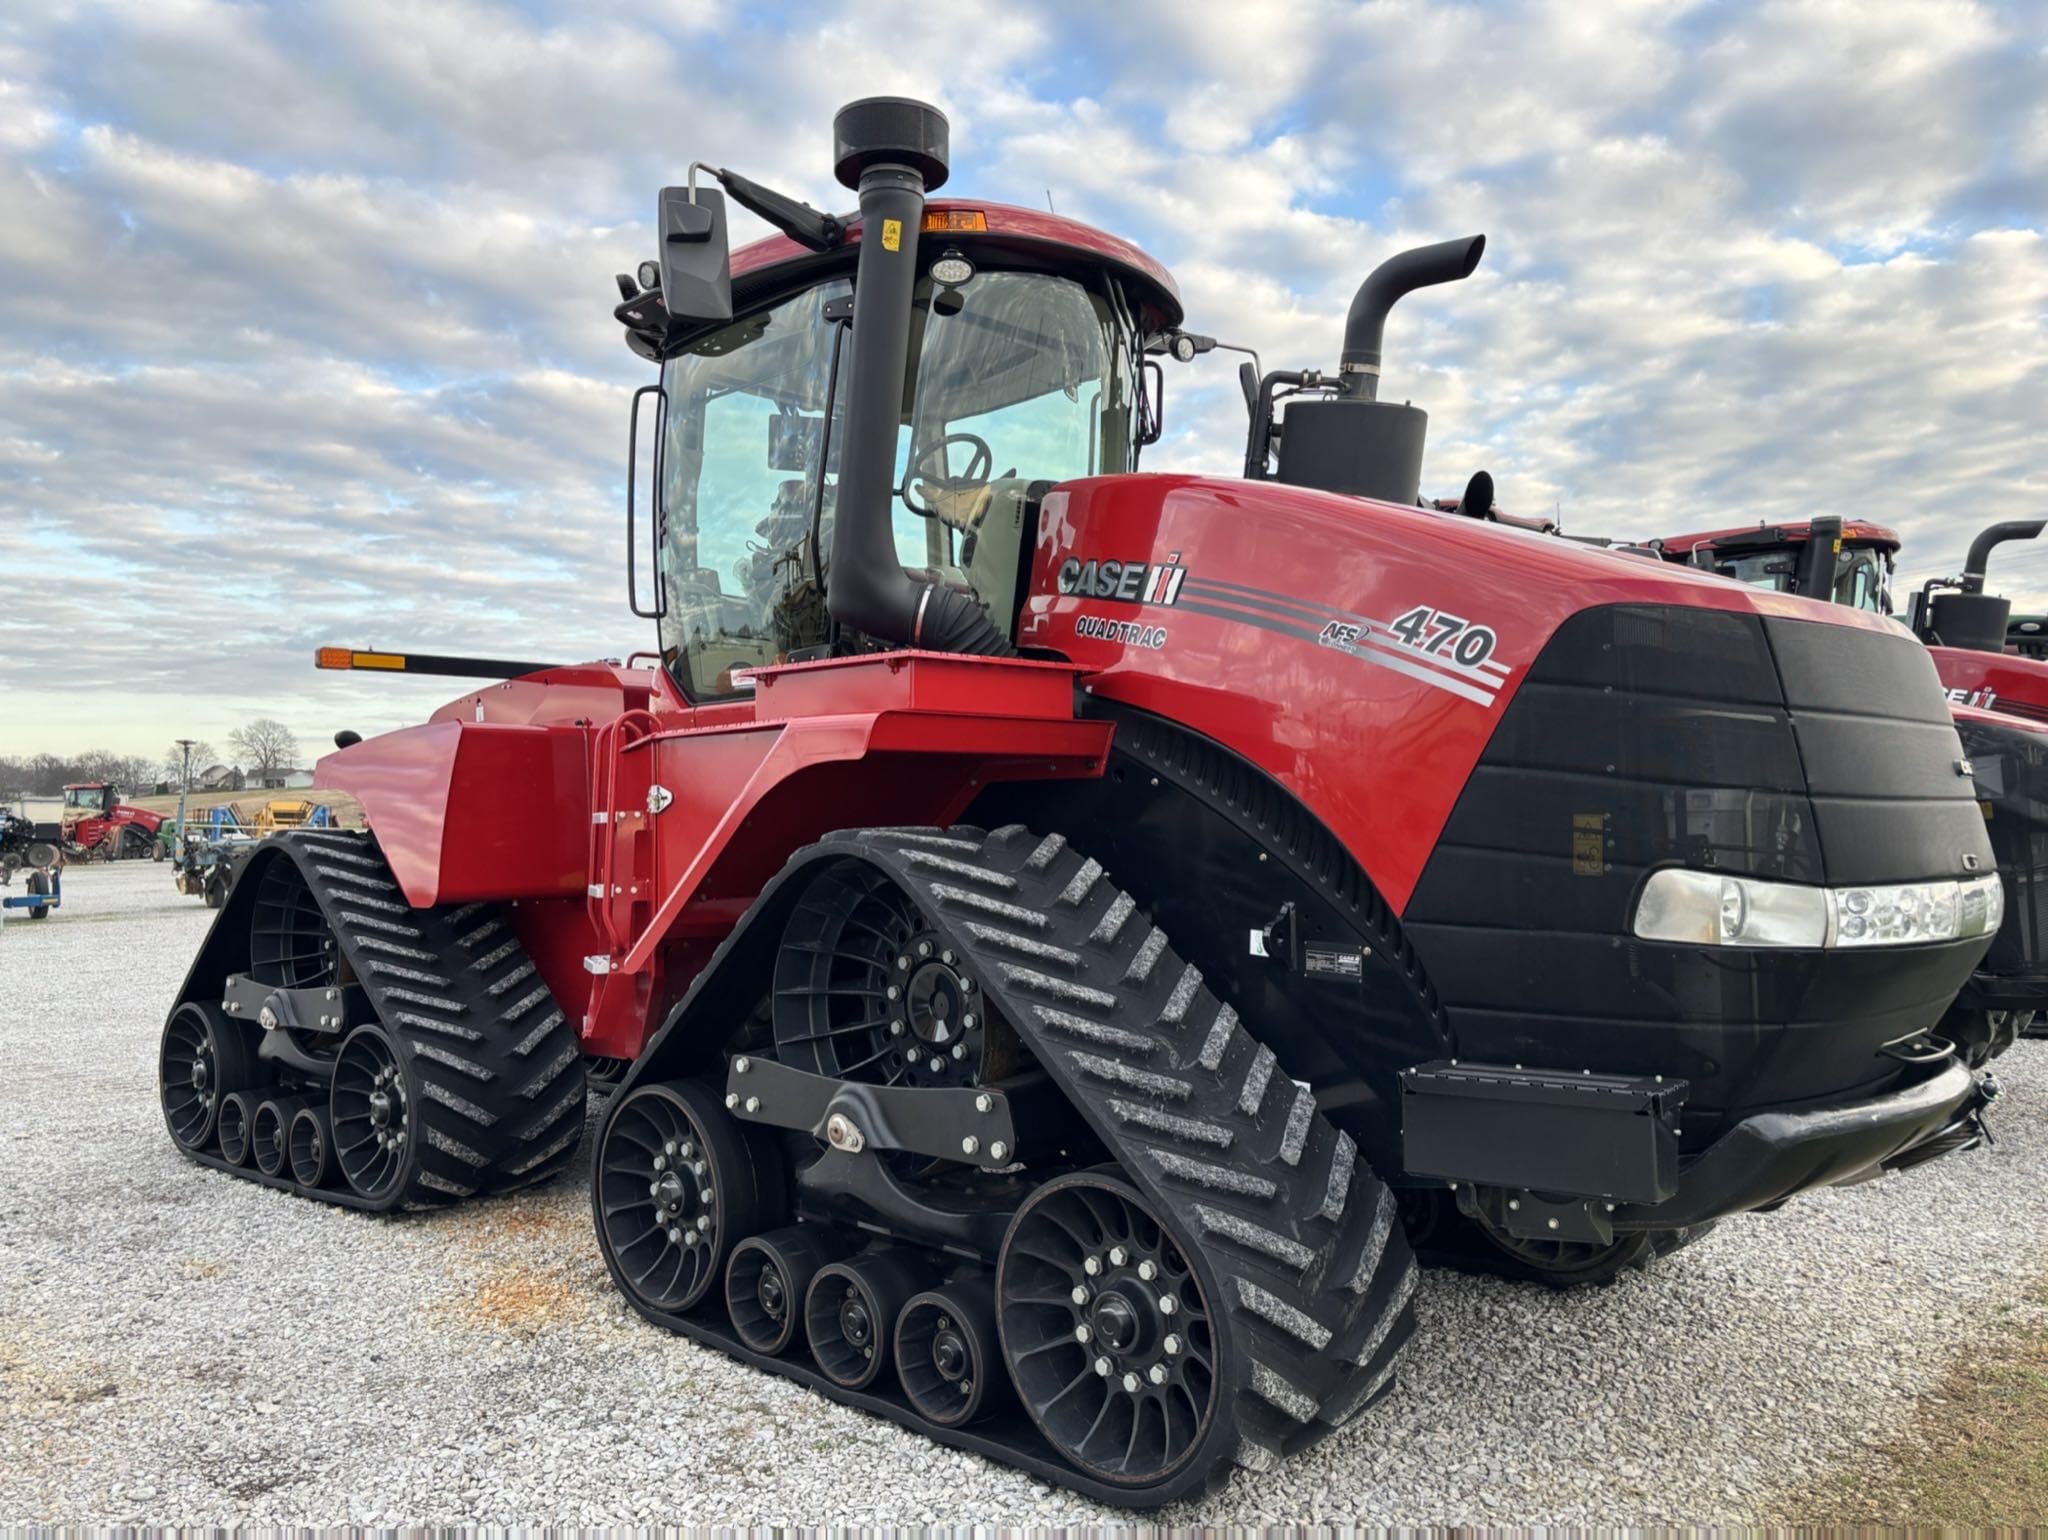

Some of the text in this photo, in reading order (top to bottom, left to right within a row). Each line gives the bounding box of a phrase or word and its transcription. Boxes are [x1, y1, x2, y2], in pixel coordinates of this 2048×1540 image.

[1057, 557, 1147, 600] CASE
[1075, 615, 1167, 650] QUADTRAC
[1320, 620, 1361, 642] AFS
[1388, 605, 1497, 668] 470
